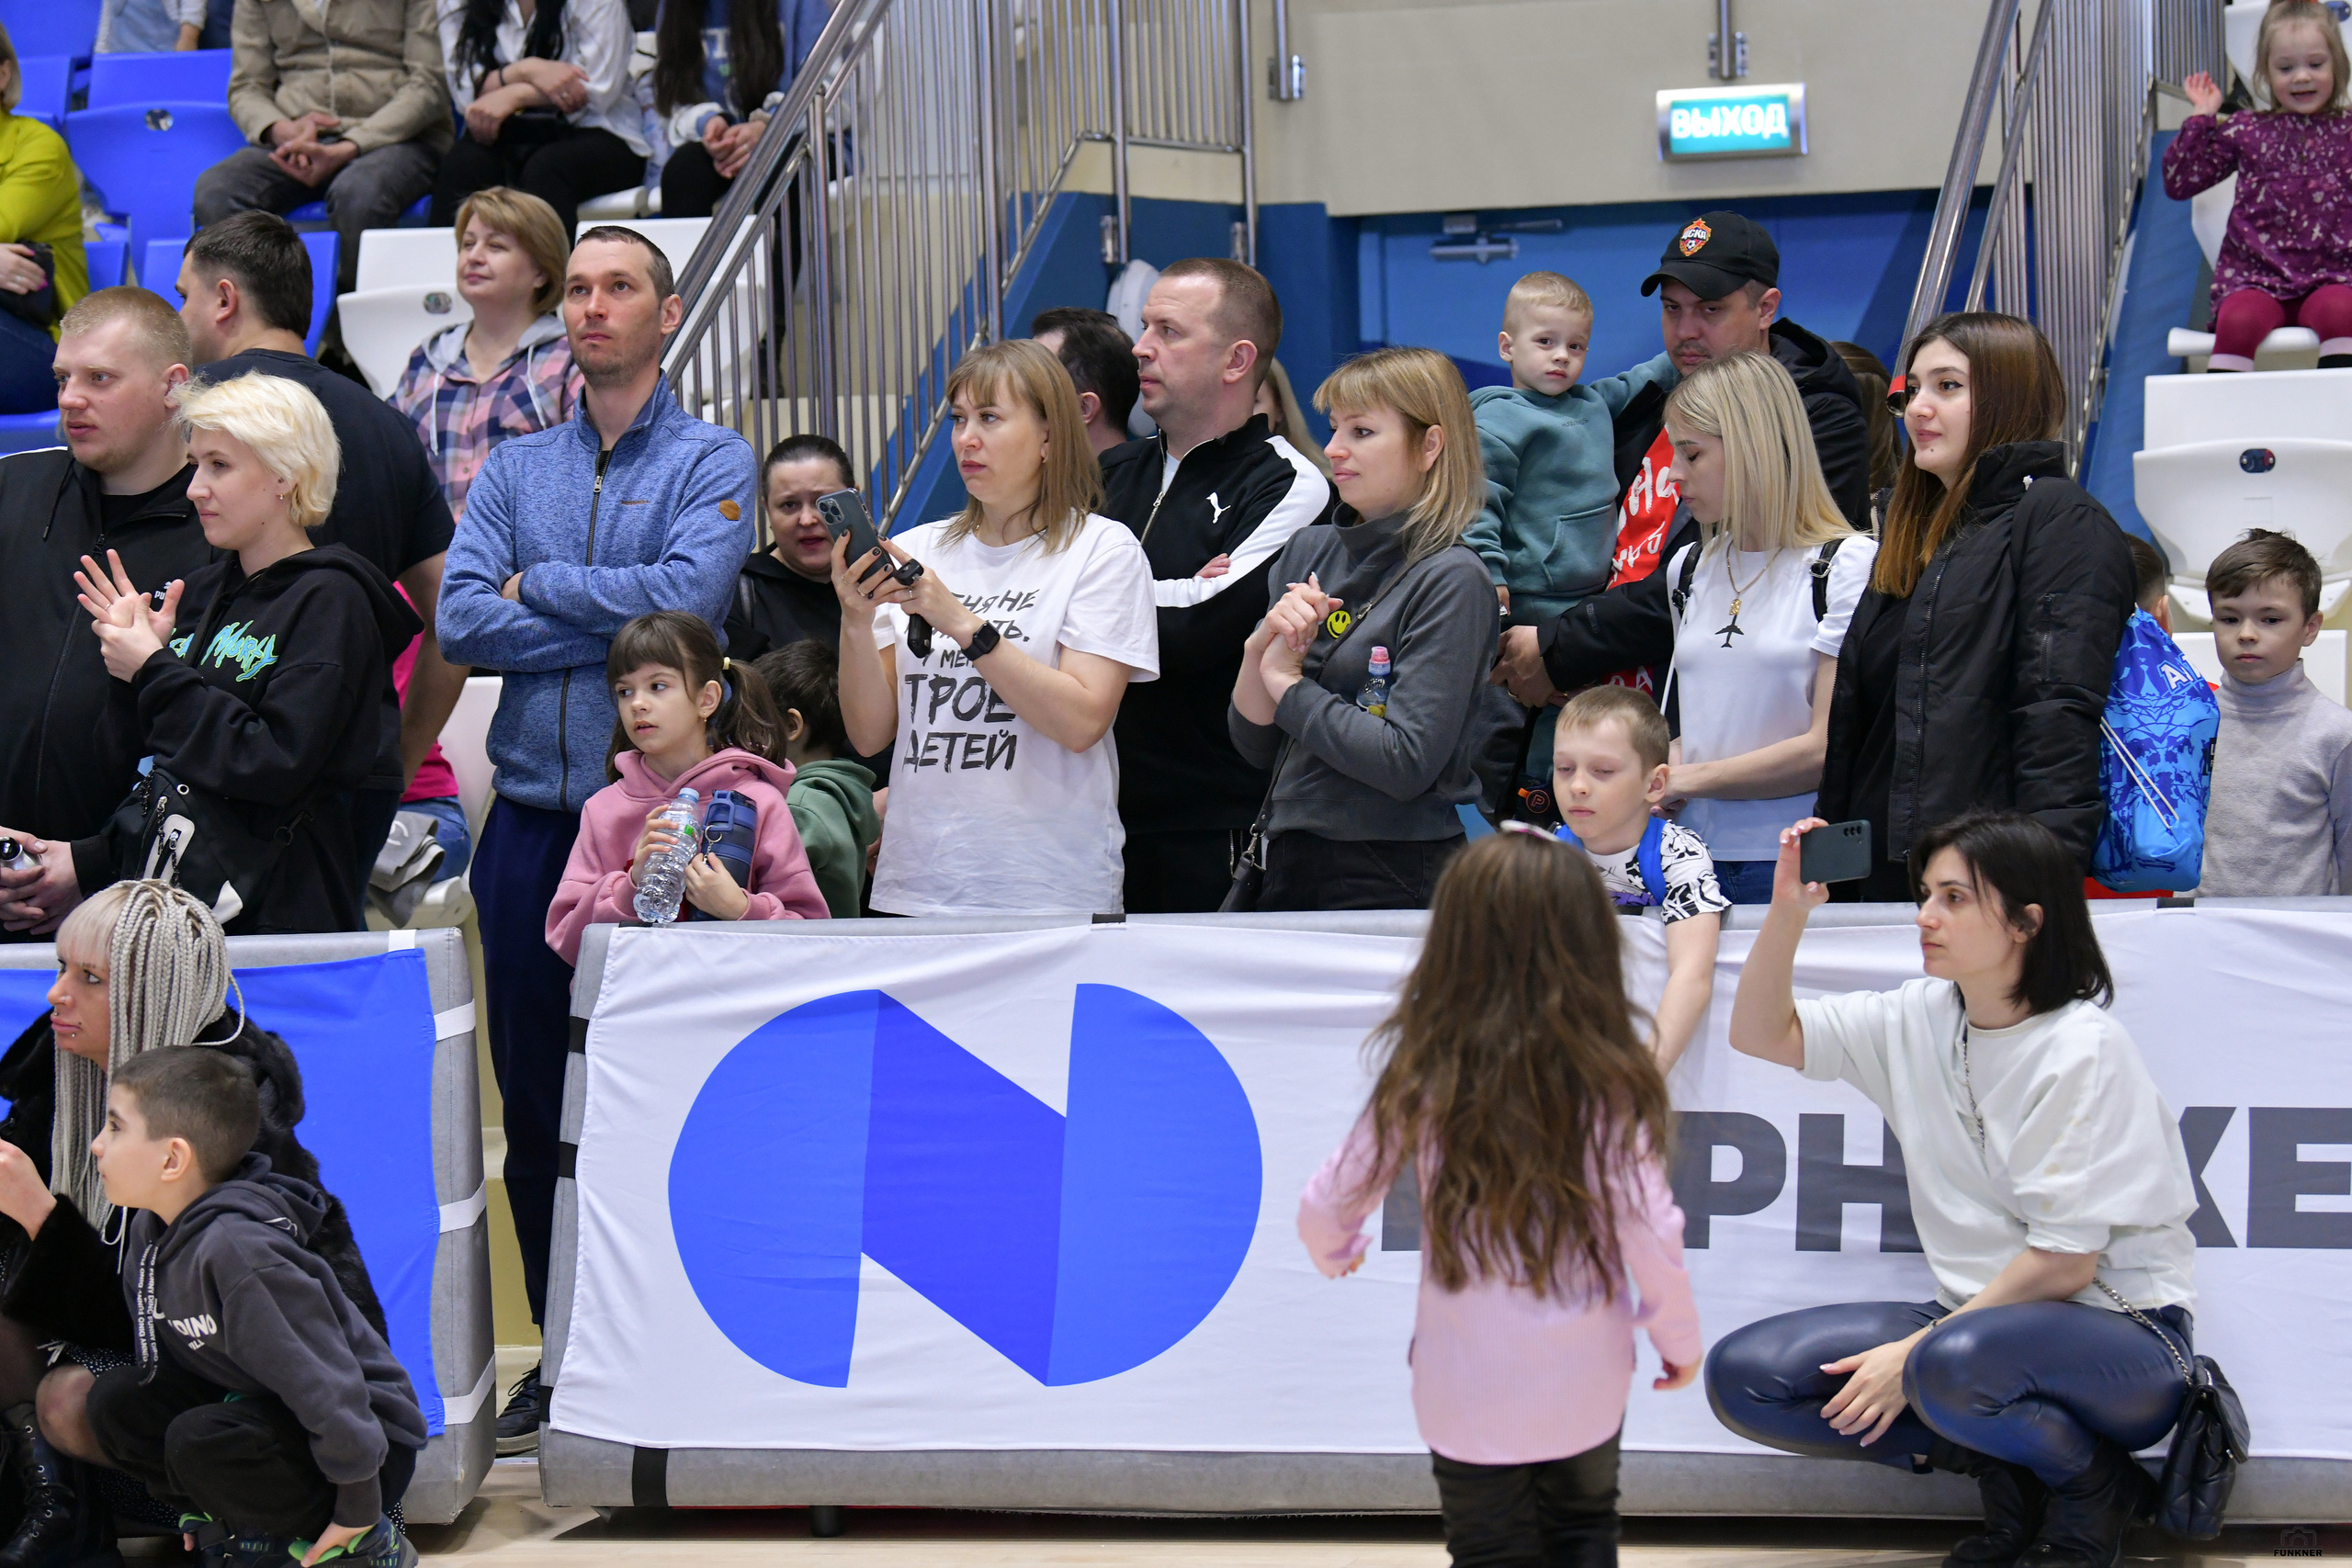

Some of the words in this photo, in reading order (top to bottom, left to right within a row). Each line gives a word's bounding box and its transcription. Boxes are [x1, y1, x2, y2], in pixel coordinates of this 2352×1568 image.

[1671, 103, 1789, 140] ВЫХОД
[154, 591, 166, 600] PU
[904, 673, 1016, 726] ТРОЕ
[901, 728, 1018, 773] ДЕТЕЙ
